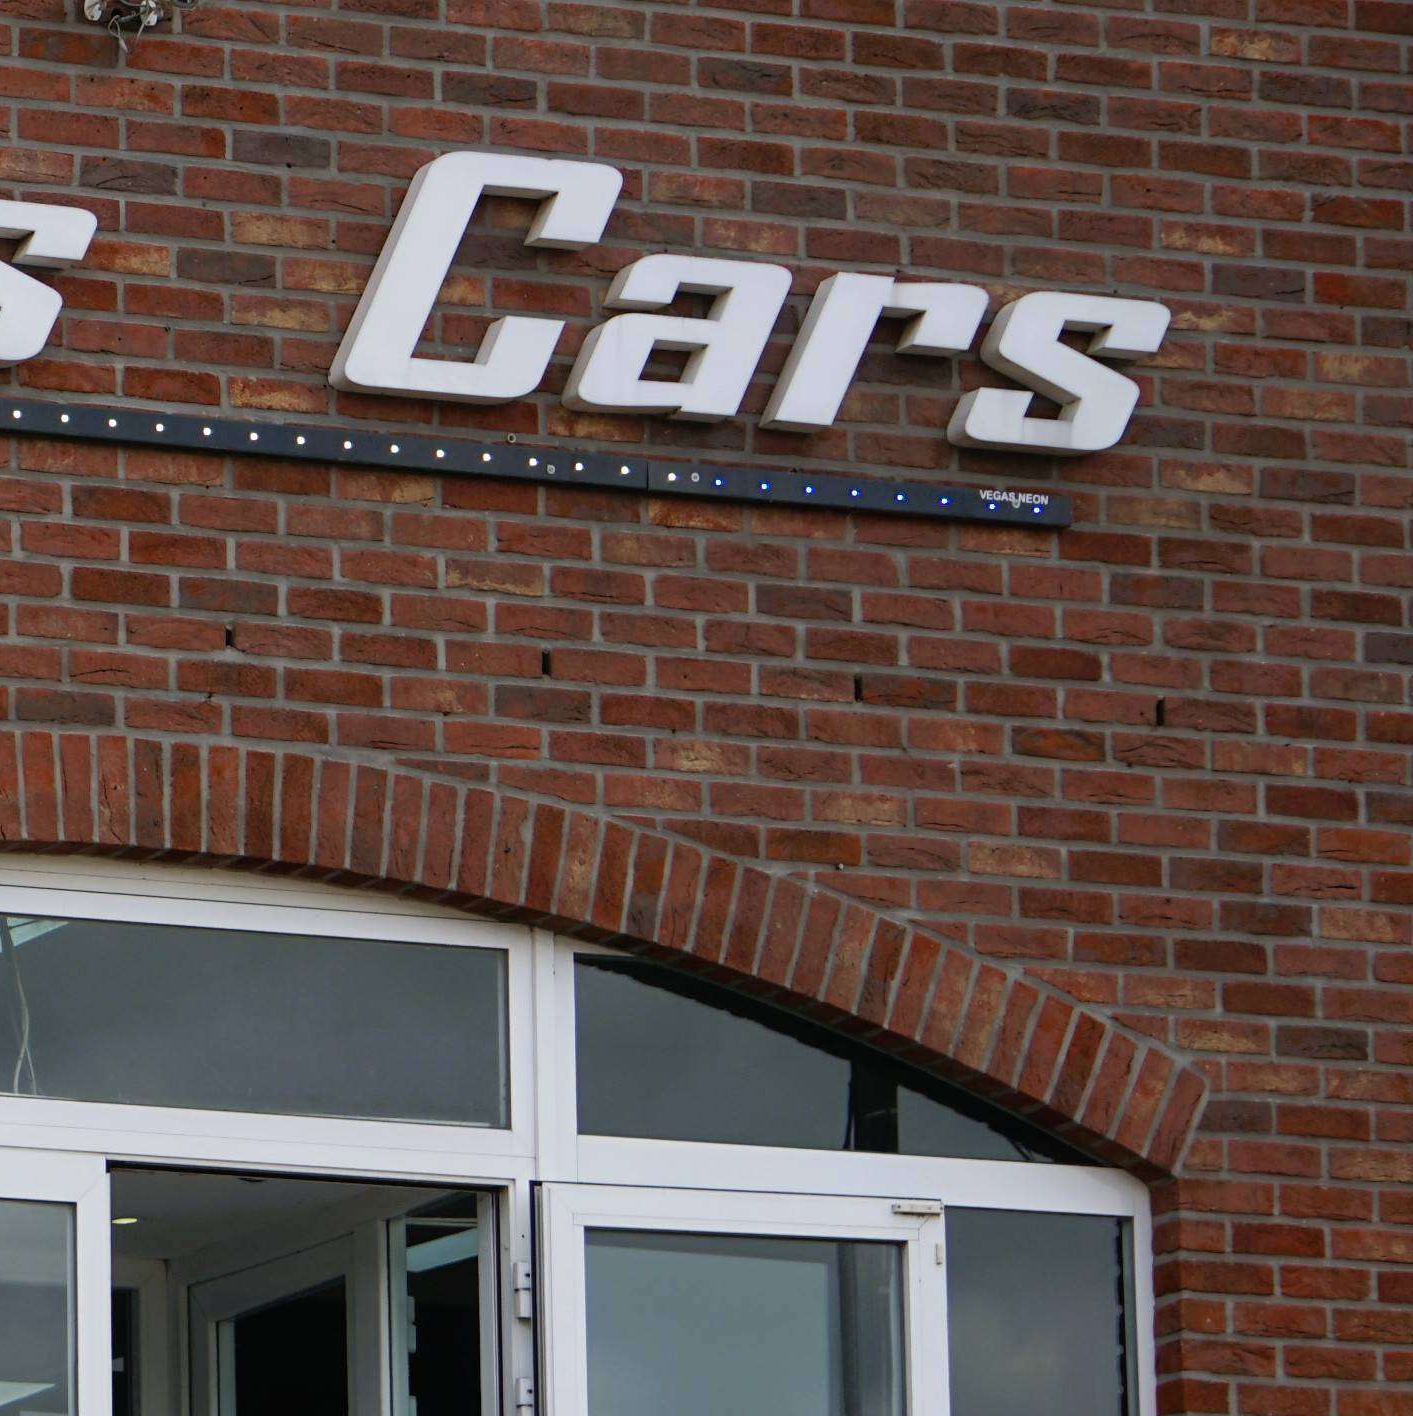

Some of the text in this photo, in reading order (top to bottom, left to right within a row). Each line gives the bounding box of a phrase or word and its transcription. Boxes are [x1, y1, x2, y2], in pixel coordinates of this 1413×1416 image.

[330, 151, 1171, 456] Cars
[979, 489, 1049, 505] VEGAS NEON
